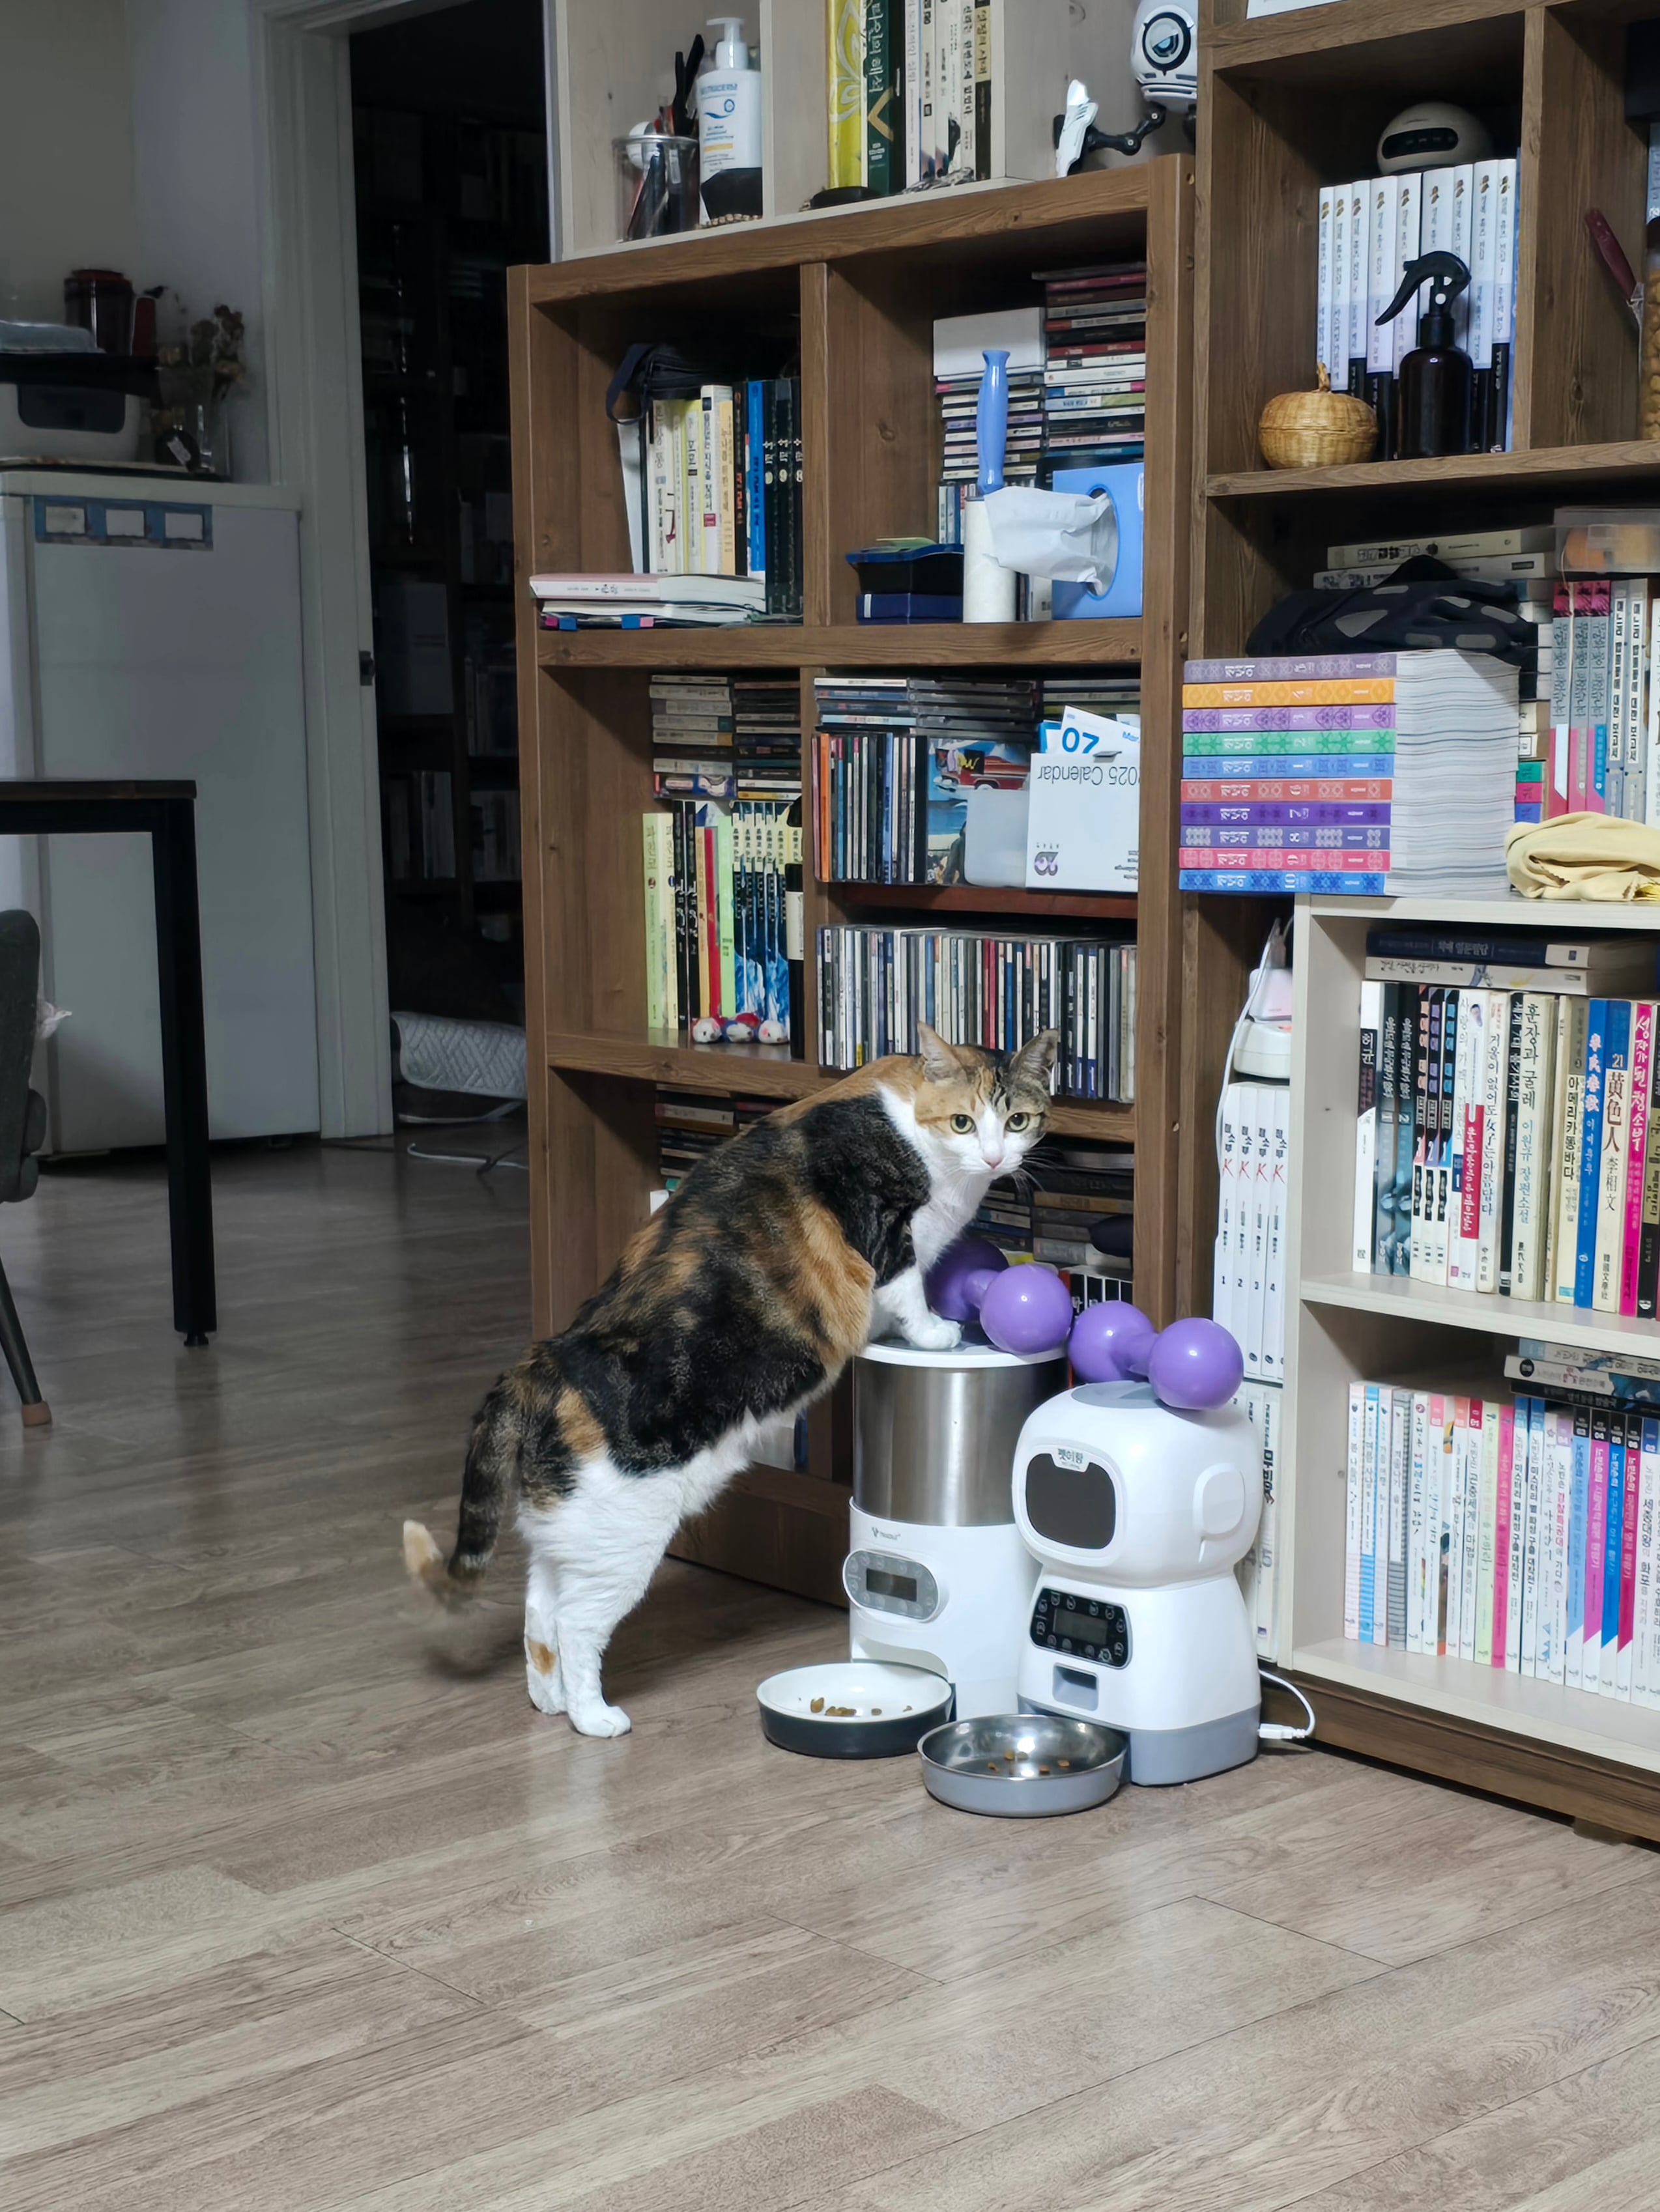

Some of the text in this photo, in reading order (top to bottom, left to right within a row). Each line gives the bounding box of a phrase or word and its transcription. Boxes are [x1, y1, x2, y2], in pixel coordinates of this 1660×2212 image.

[868, 3, 885, 93] 타인의 해석
[1573, 622, 1588, 716] 무궁화 꽃이 피었습니다
[1590, 623, 1606, 717] 무궁화 꽃이 피었습니다
[1037, 765, 1140, 786] Calendar 025
[1522, 1004, 1540, 1110] 훈장과 굴레
[1612, 1054, 1624, 1068] 21
[1631, 1016, 1652, 1152] 성자가 된 청소부
[1222, 1157, 1235, 1178] K
[1238, 1160, 1251, 1180] K
[1255, 1163, 1268, 1183] K
[1272, 1164, 1285, 1185] K
[1057, 1447, 1083, 1464] 펫이랑
[1594, 1447, 1604, 1482] 노빈손의
[1610, 1452, 1620, 1488] 노빈손의
[1626, 1456, 1637, 1492] 노빈손의
